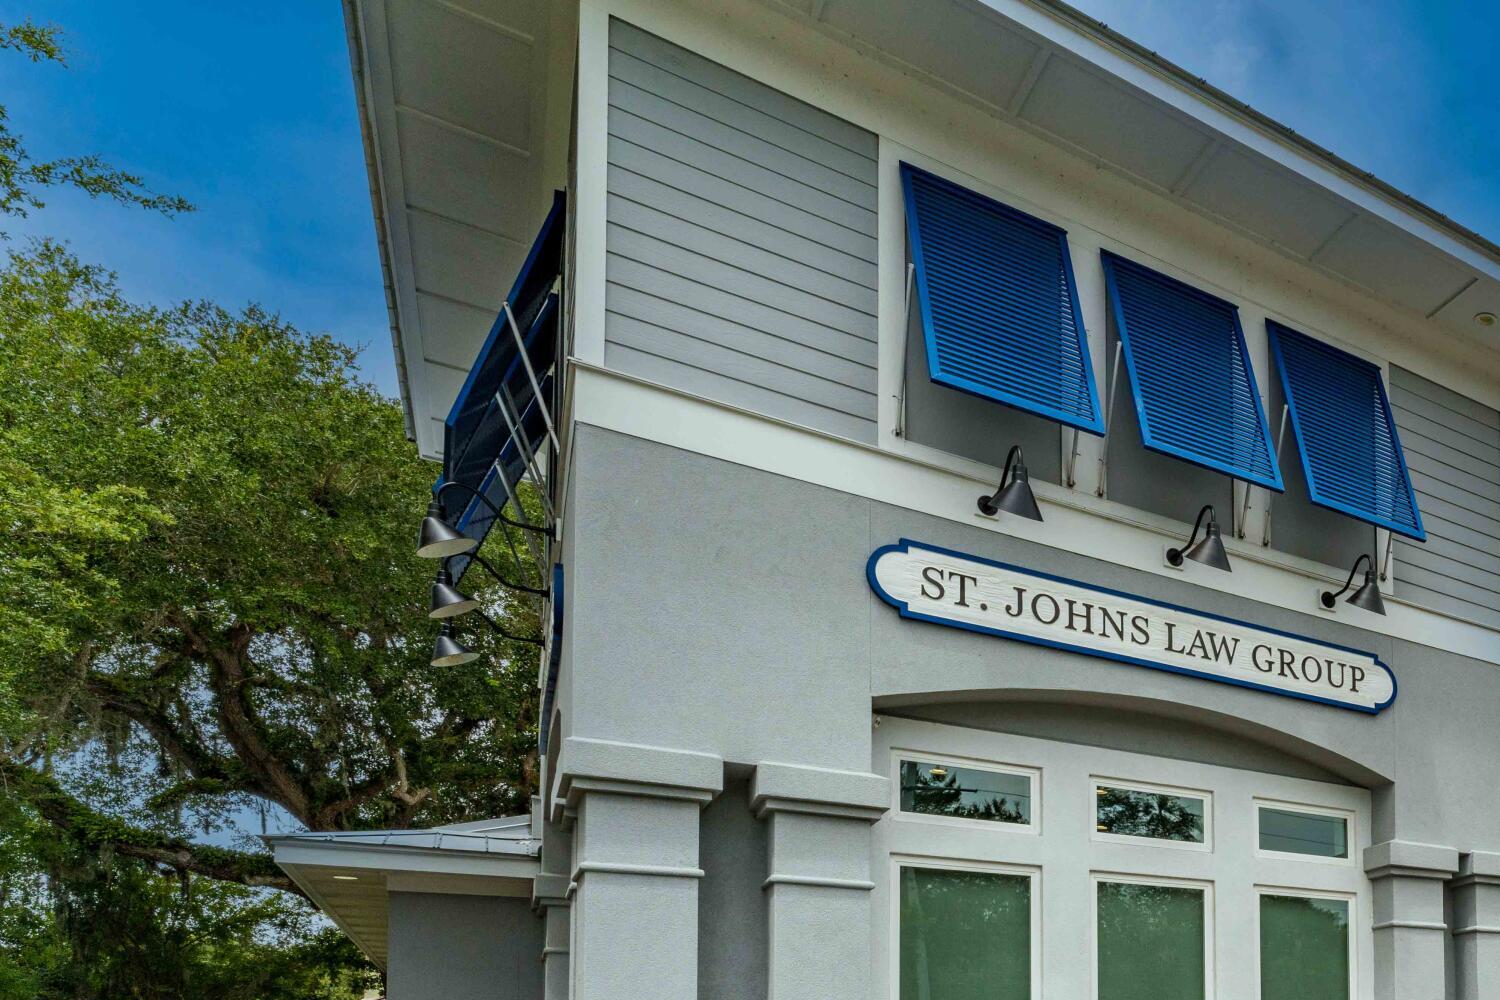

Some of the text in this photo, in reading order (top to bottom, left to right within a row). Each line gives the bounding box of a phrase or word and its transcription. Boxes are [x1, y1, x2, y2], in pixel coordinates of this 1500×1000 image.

[920, 566, 1365, 693] ST. JOHNS LAW GROUP
